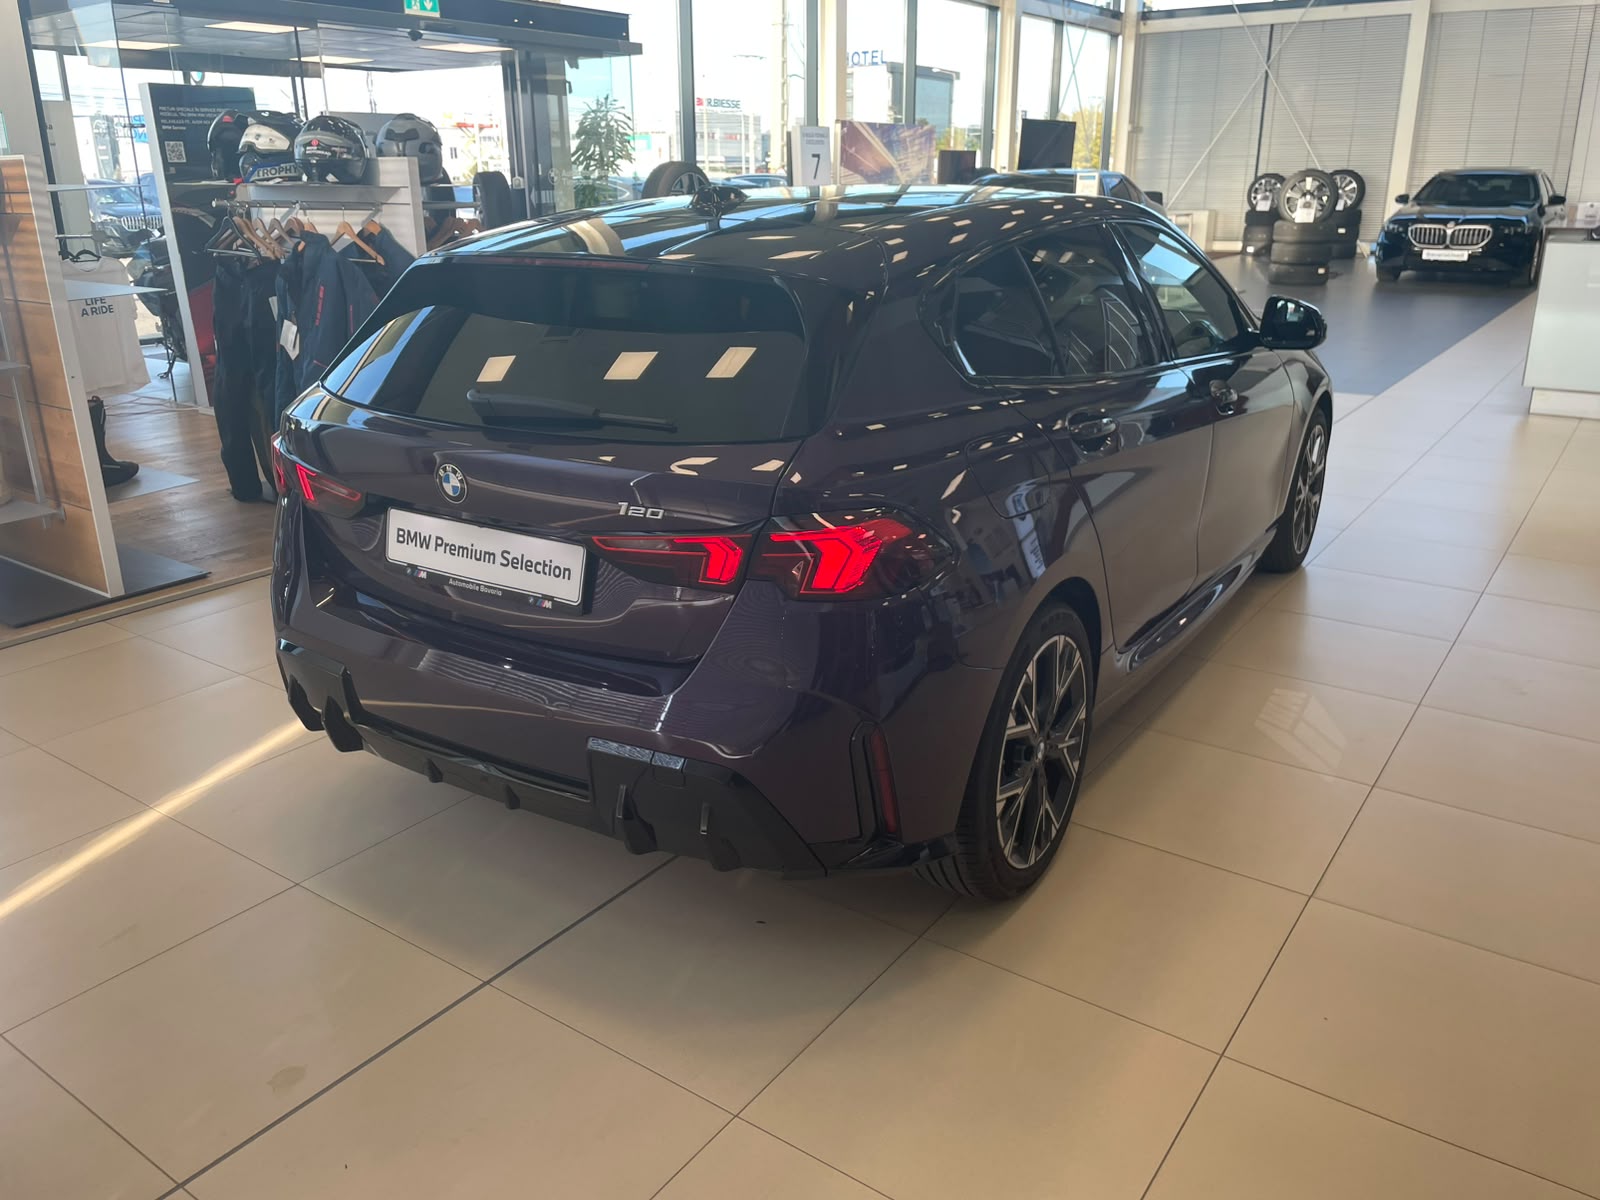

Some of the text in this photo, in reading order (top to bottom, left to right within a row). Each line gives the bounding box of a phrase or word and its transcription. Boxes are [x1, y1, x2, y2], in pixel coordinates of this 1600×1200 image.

[811, 153, 821, 180] 7
[85, 296, 107, 306] LIFE
[81, 304, 114, 317] A RIDE
[618, 502, 664, 520] 120
[396, 527, 572, 580] BMW Premium Selection
[449, 578, 502, 597] Automobile Bavaria
